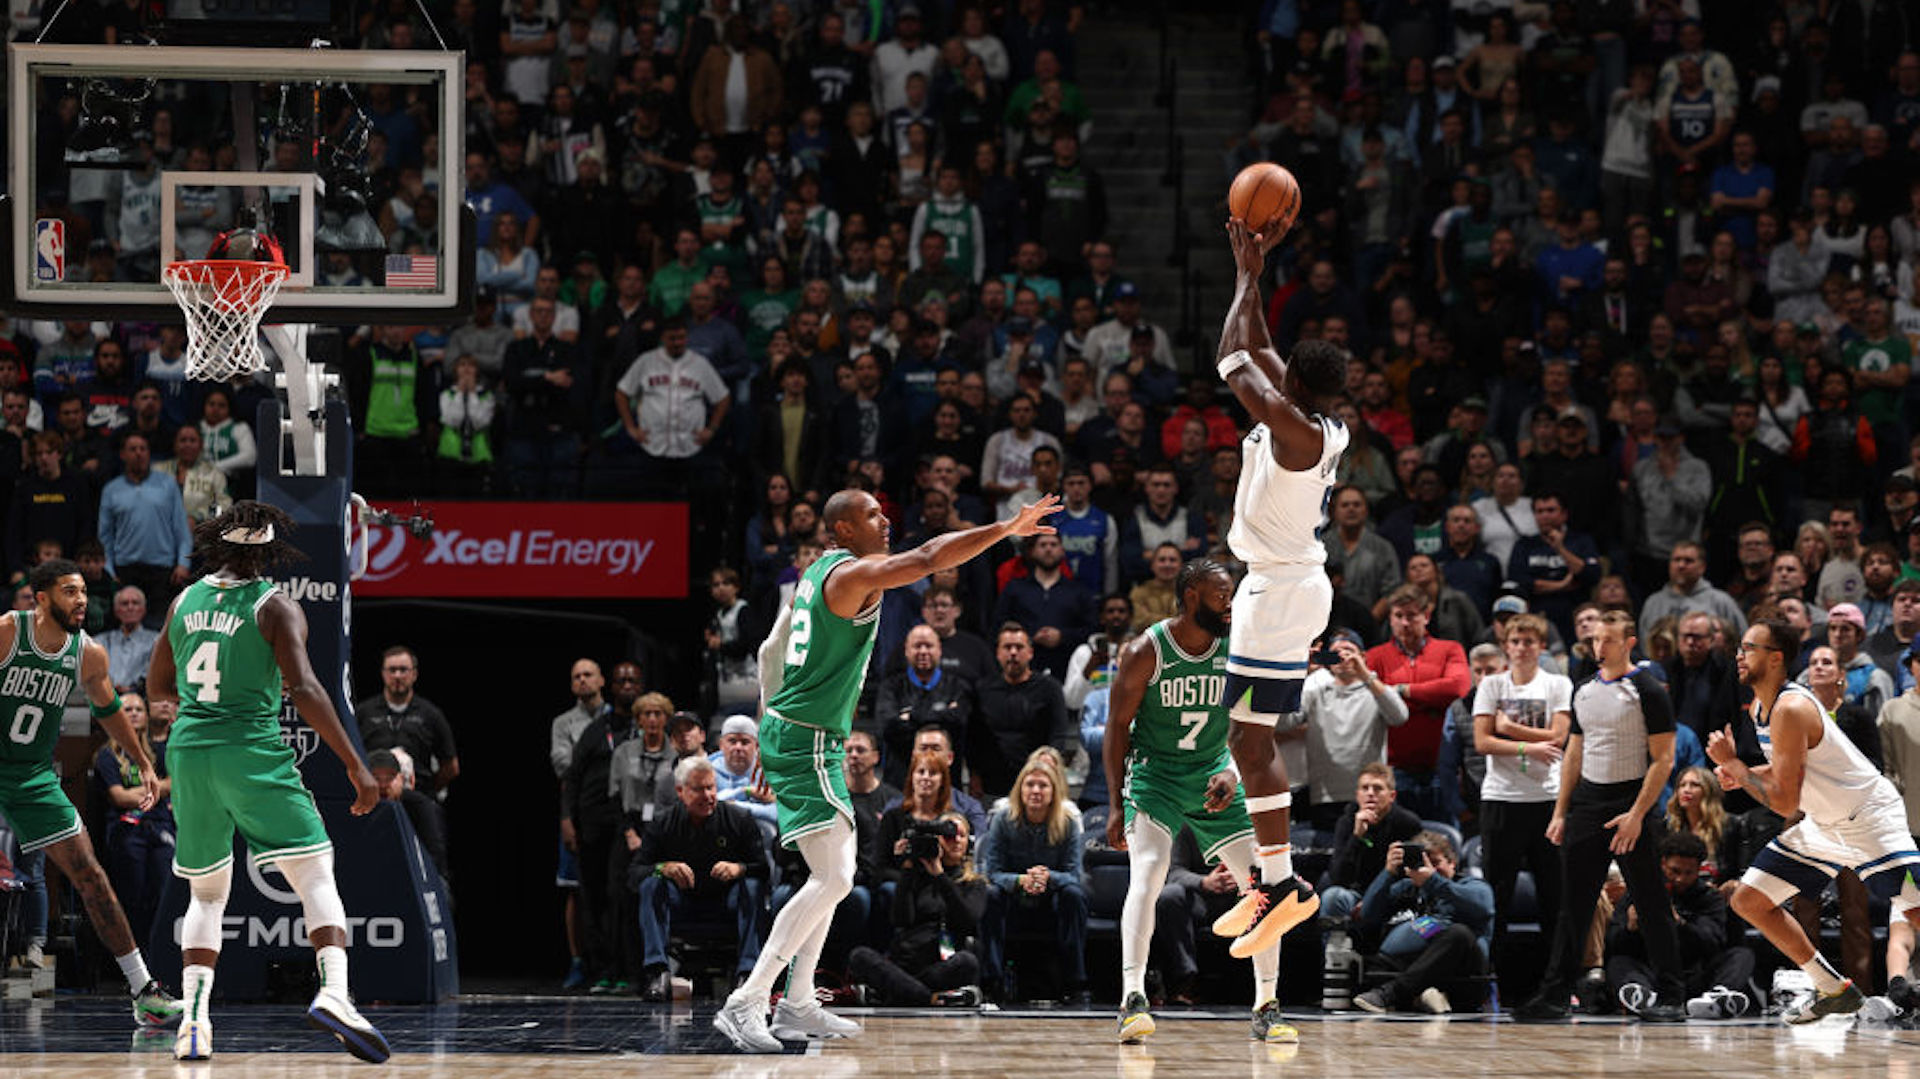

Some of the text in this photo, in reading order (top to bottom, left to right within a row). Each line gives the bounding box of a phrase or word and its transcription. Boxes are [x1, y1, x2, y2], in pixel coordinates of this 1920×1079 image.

[423, 531, 653, 574] Xcel Energy
[183, 610, 245, 637] HOLIDAY
[1, 666, 74, 708] BOSTON
[186, 641, 221, 703] 4
[9, 704, 45, 745] 0
[1178, 711, 1209, 750] 7
[173, 917, 404, 948] FMTO
